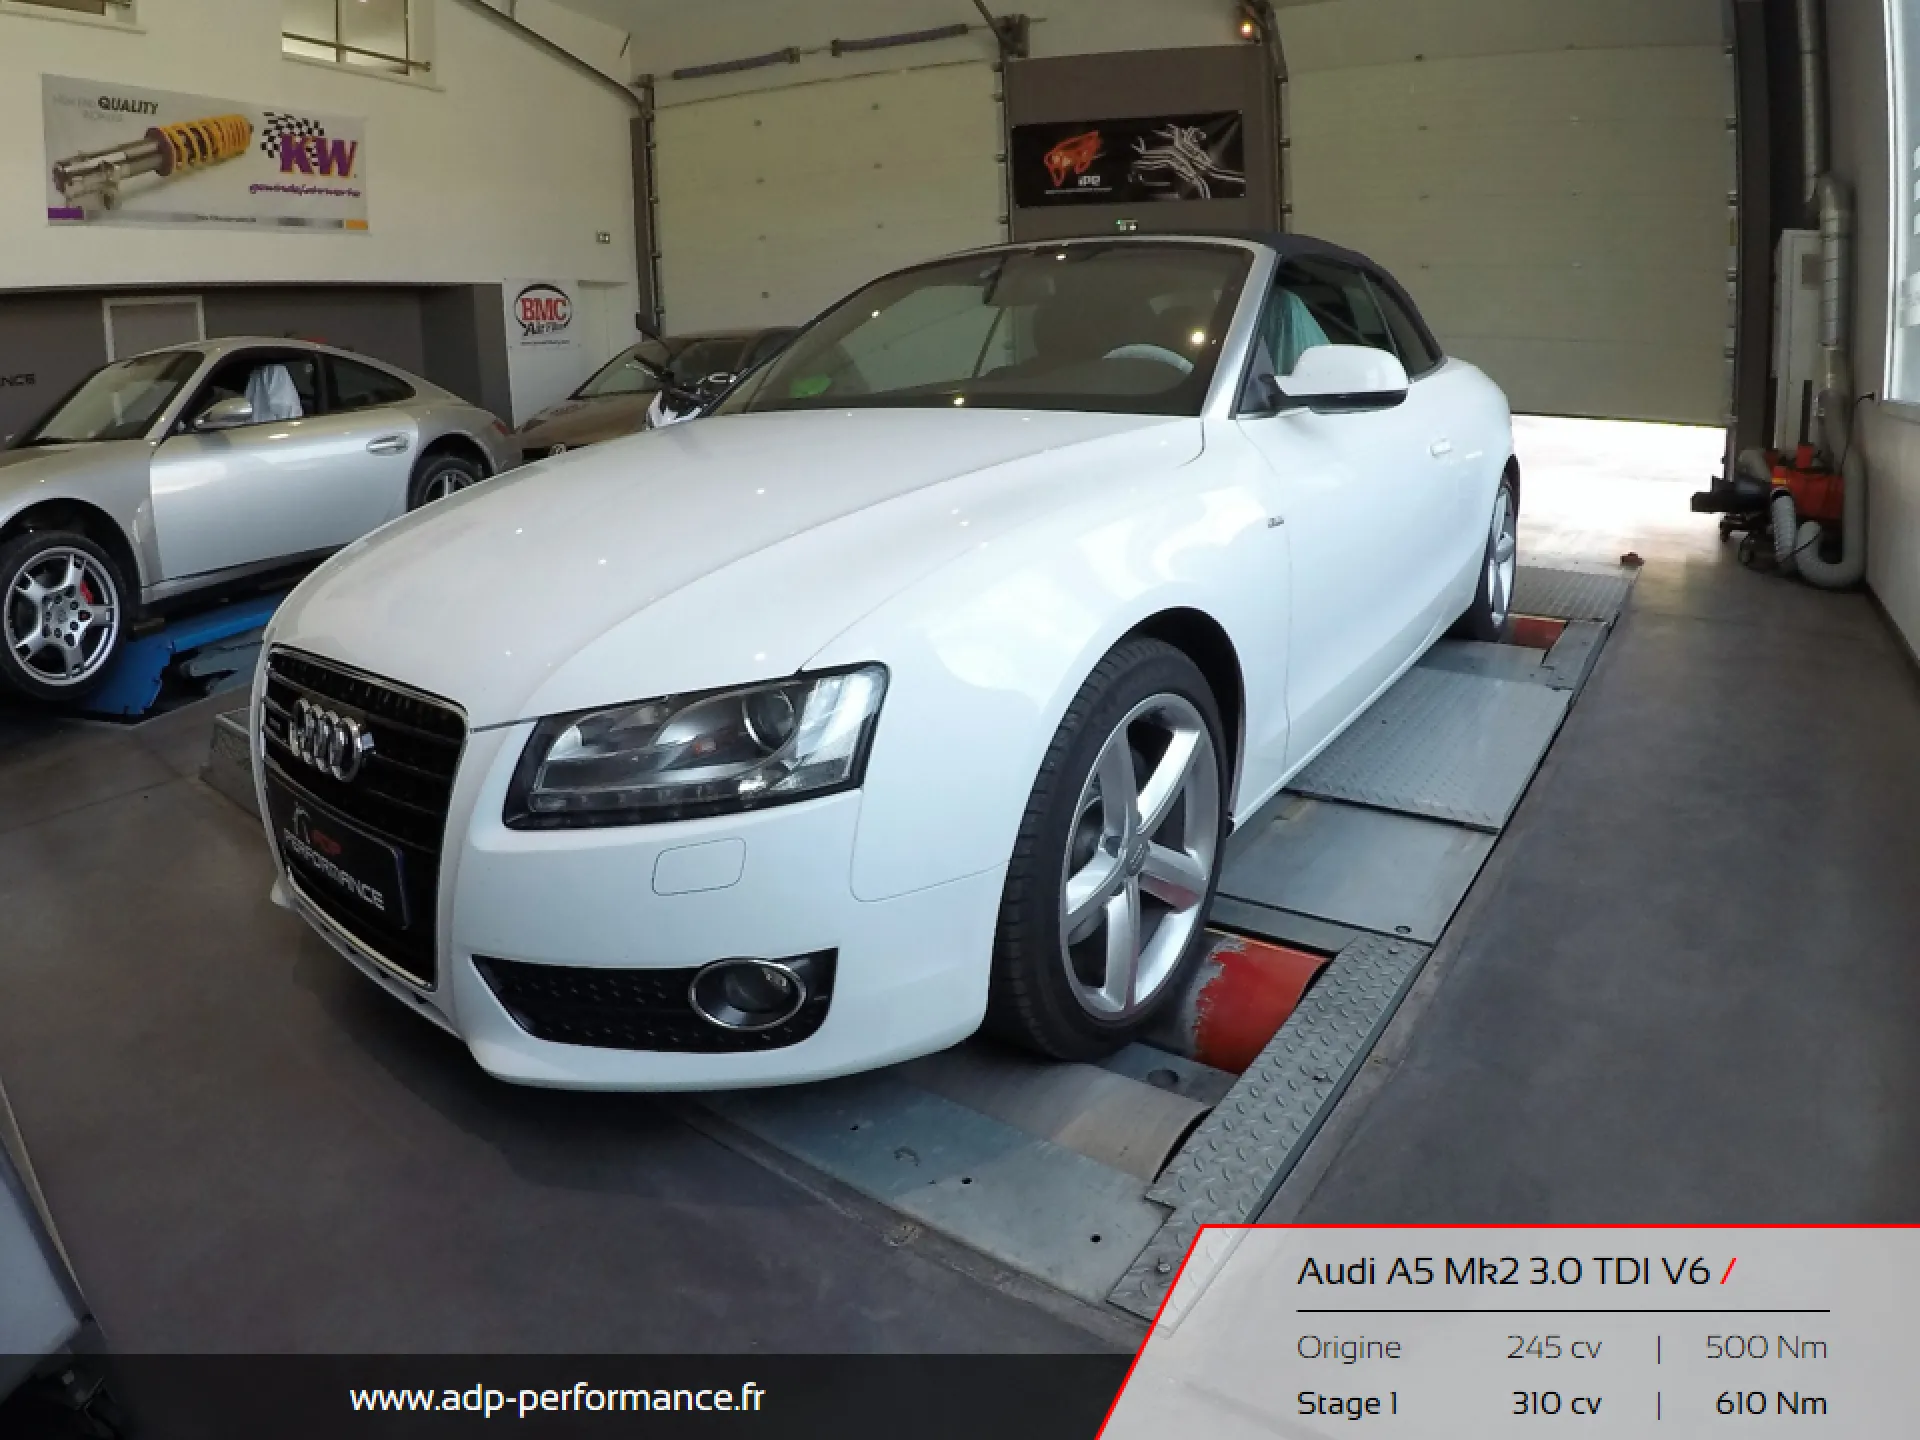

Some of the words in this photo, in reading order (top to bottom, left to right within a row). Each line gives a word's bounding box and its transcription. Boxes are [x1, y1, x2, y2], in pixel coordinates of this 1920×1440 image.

[97, 95, 159, 115] QUALITY
[279, 132, 358, 178] KW
[520, 297, 568, 321] BMC
